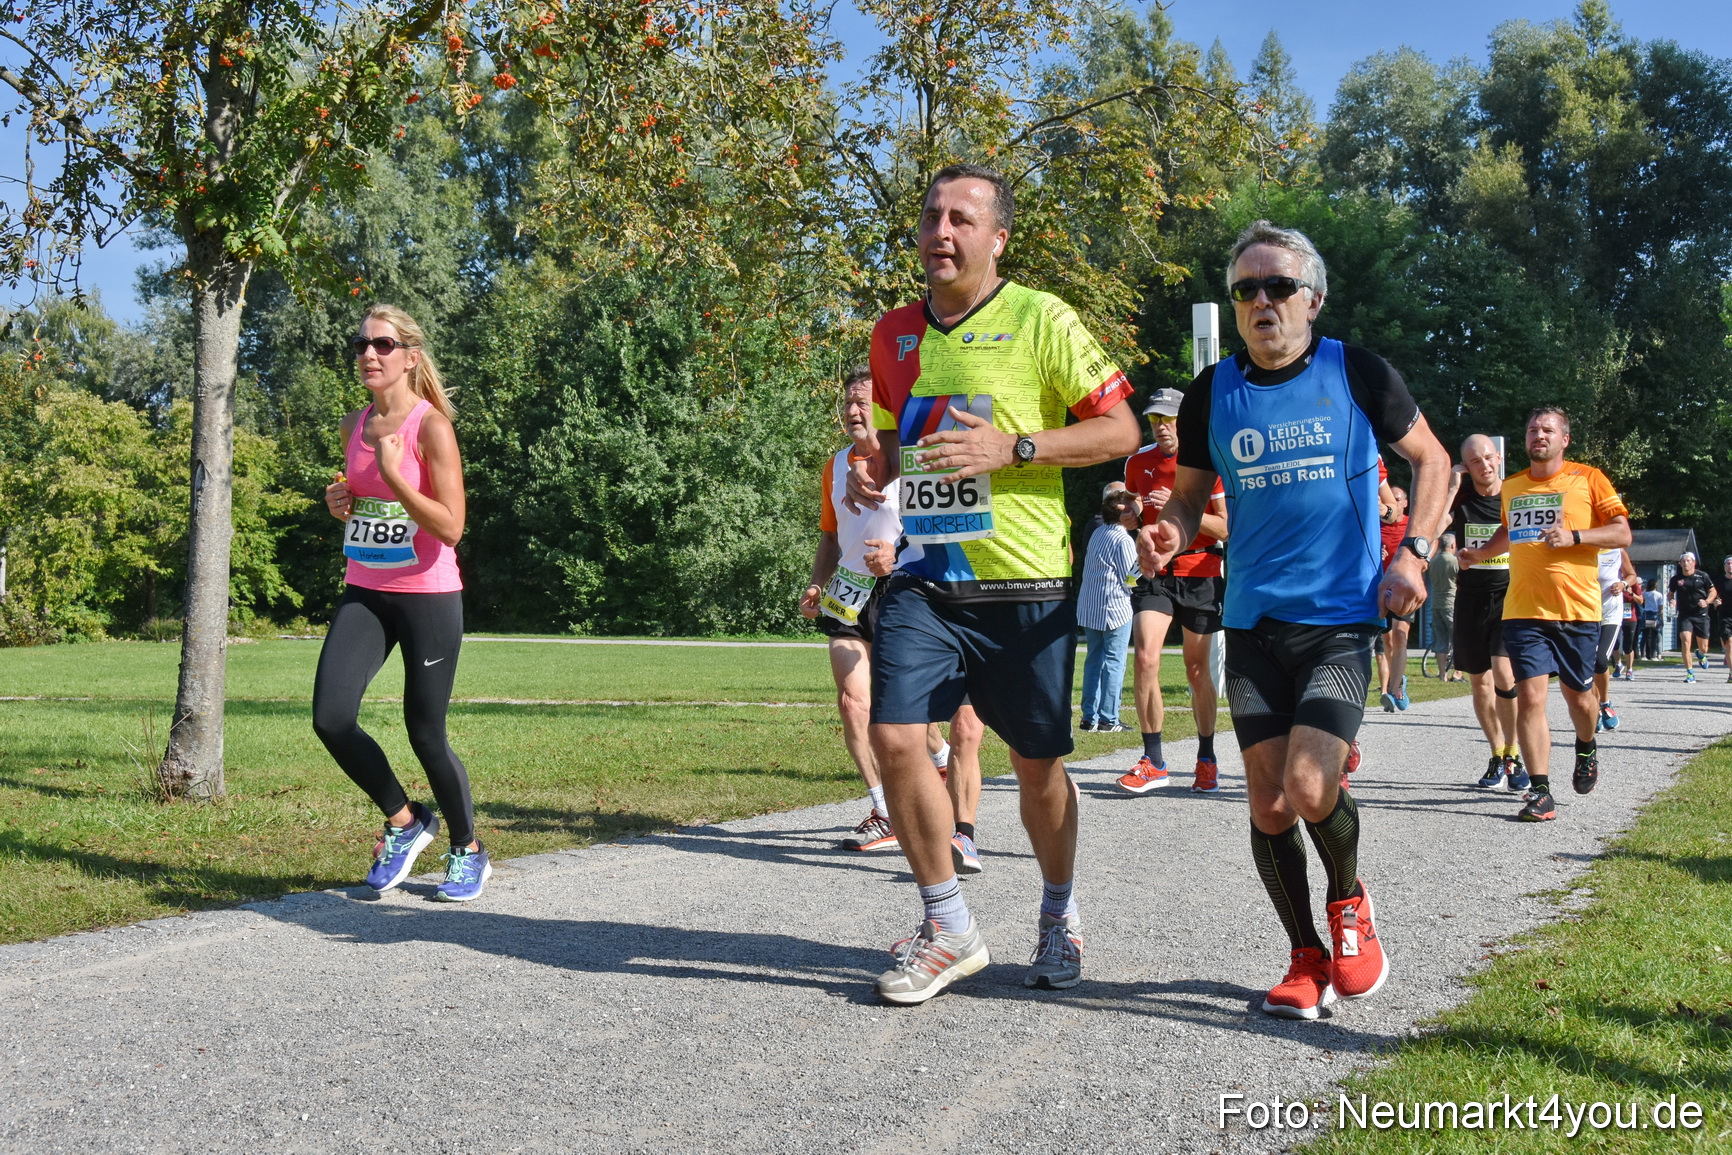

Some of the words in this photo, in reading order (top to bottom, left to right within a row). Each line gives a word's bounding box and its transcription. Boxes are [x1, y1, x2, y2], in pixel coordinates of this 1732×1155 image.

[1268, 416, 1332, 429] Versicherungsbüro
[1268, 424, 1309, 441] LEIDL
[1313, 422, 1326, 433] &
[1269, 433, 1332, 453] INDERST
[1282, 461, 1301, 469] LEIDL
[1240, 476, 1267, 491] TSG
[1271, 471, 1292, 486] 08
[1297, 466, 1335, 482] Roth
[905, 478, 979, 510] 2696
[1512, 495, 1559, 509] BOCK
[354, 499, 407, 516] BOCK
[915, 512, 990, 534] NORBERT
[1513, 510, 1556, 527] 2159
[350, 519, 408, 545] 2788
[1469, 526, 1498, 537] BOC
[1518, 530, 1542, 538] TOBI
[827, 601, 846, 616] RAINER
